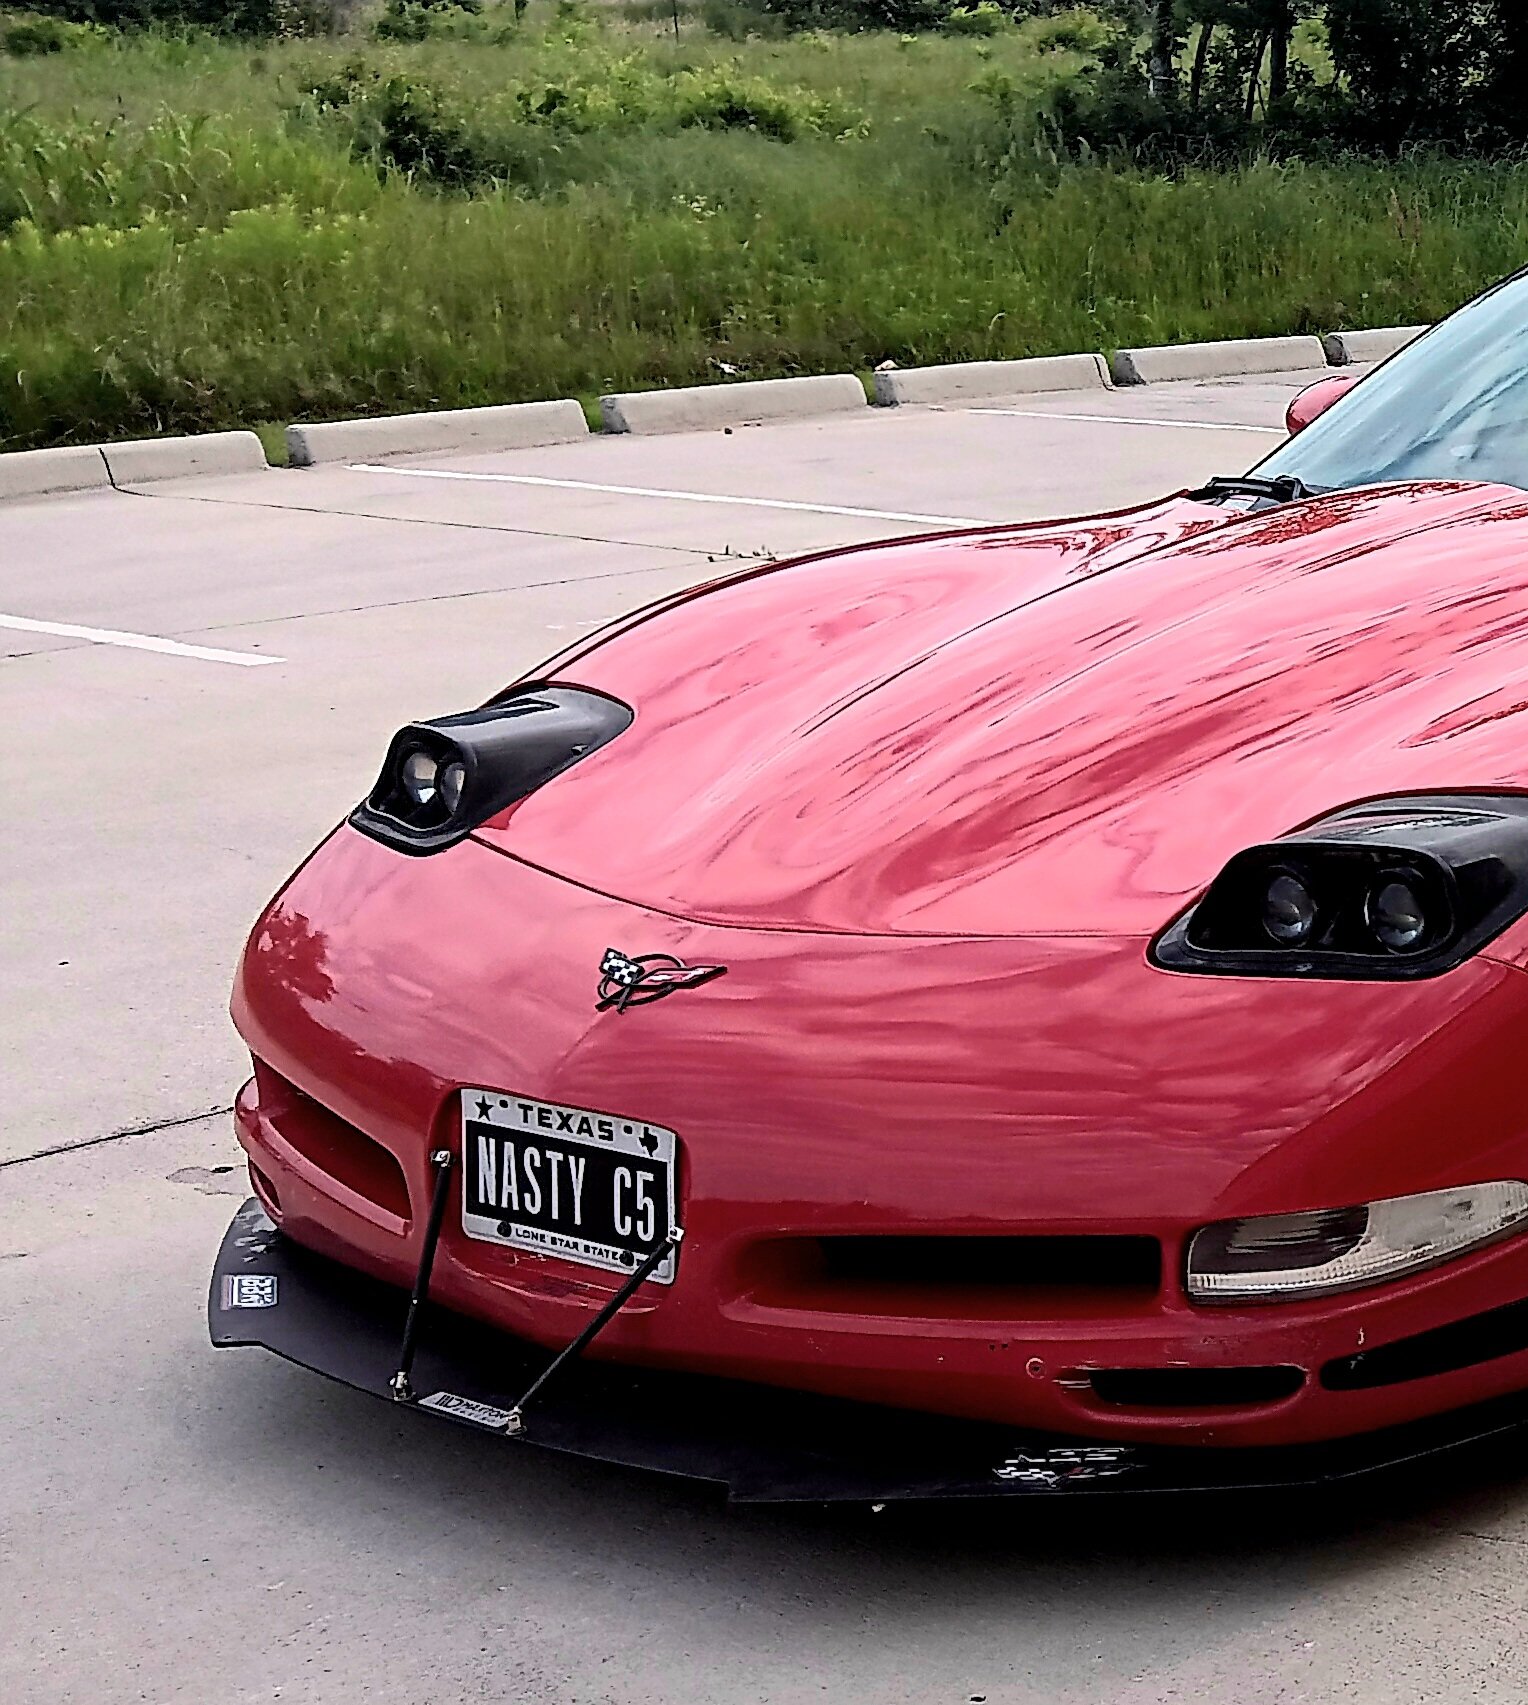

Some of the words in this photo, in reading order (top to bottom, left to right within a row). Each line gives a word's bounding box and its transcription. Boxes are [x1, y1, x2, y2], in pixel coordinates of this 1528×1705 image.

[517, 1103, 615, 1142] TEXAS
[477, 1135, 586, 1225] NASTY
[613, 1166, 656, 1243] C5
[515, 1228, 547, 1244] LONE
[550, 1236, 581, 1253] STAR
[583, 1244, 619, 1262] STATE
